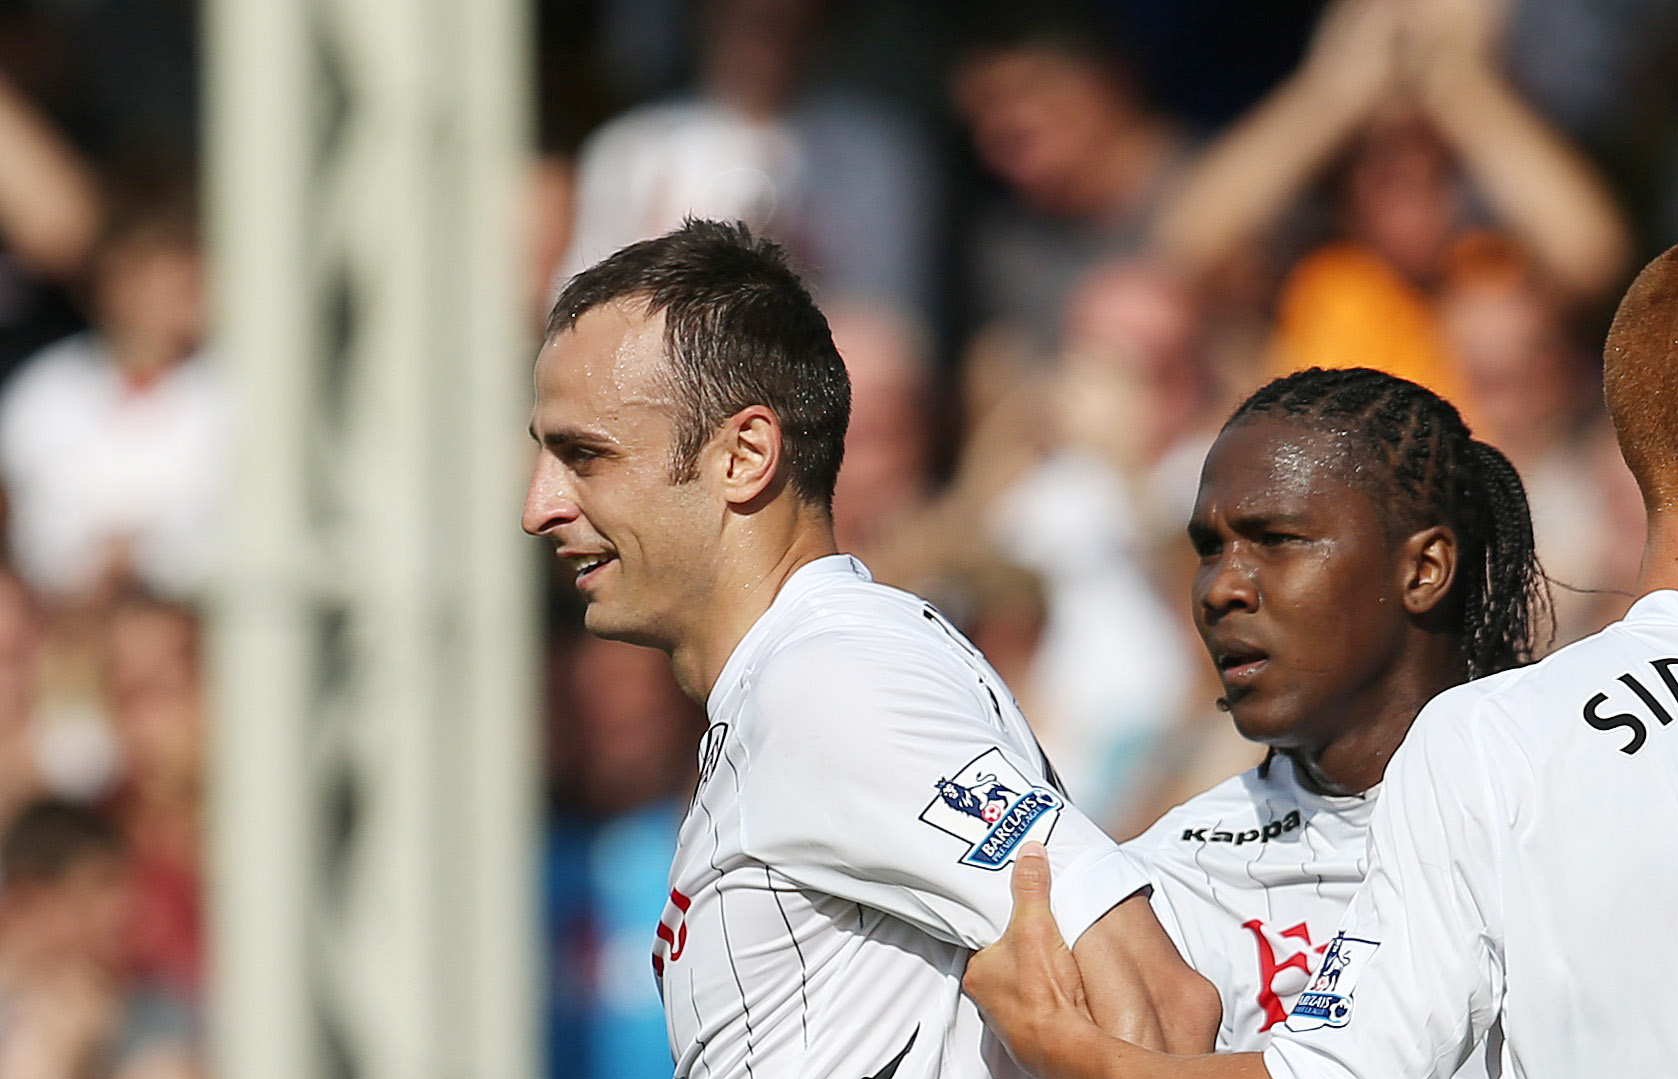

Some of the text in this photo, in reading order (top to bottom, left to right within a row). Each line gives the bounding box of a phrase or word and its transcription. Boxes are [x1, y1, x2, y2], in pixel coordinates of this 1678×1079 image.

[981, 796, 1038, 857] BARCLAYS
[1181, 808, 1300, 846] Kappa
[992, 830, 1020, 863] PREMIER
